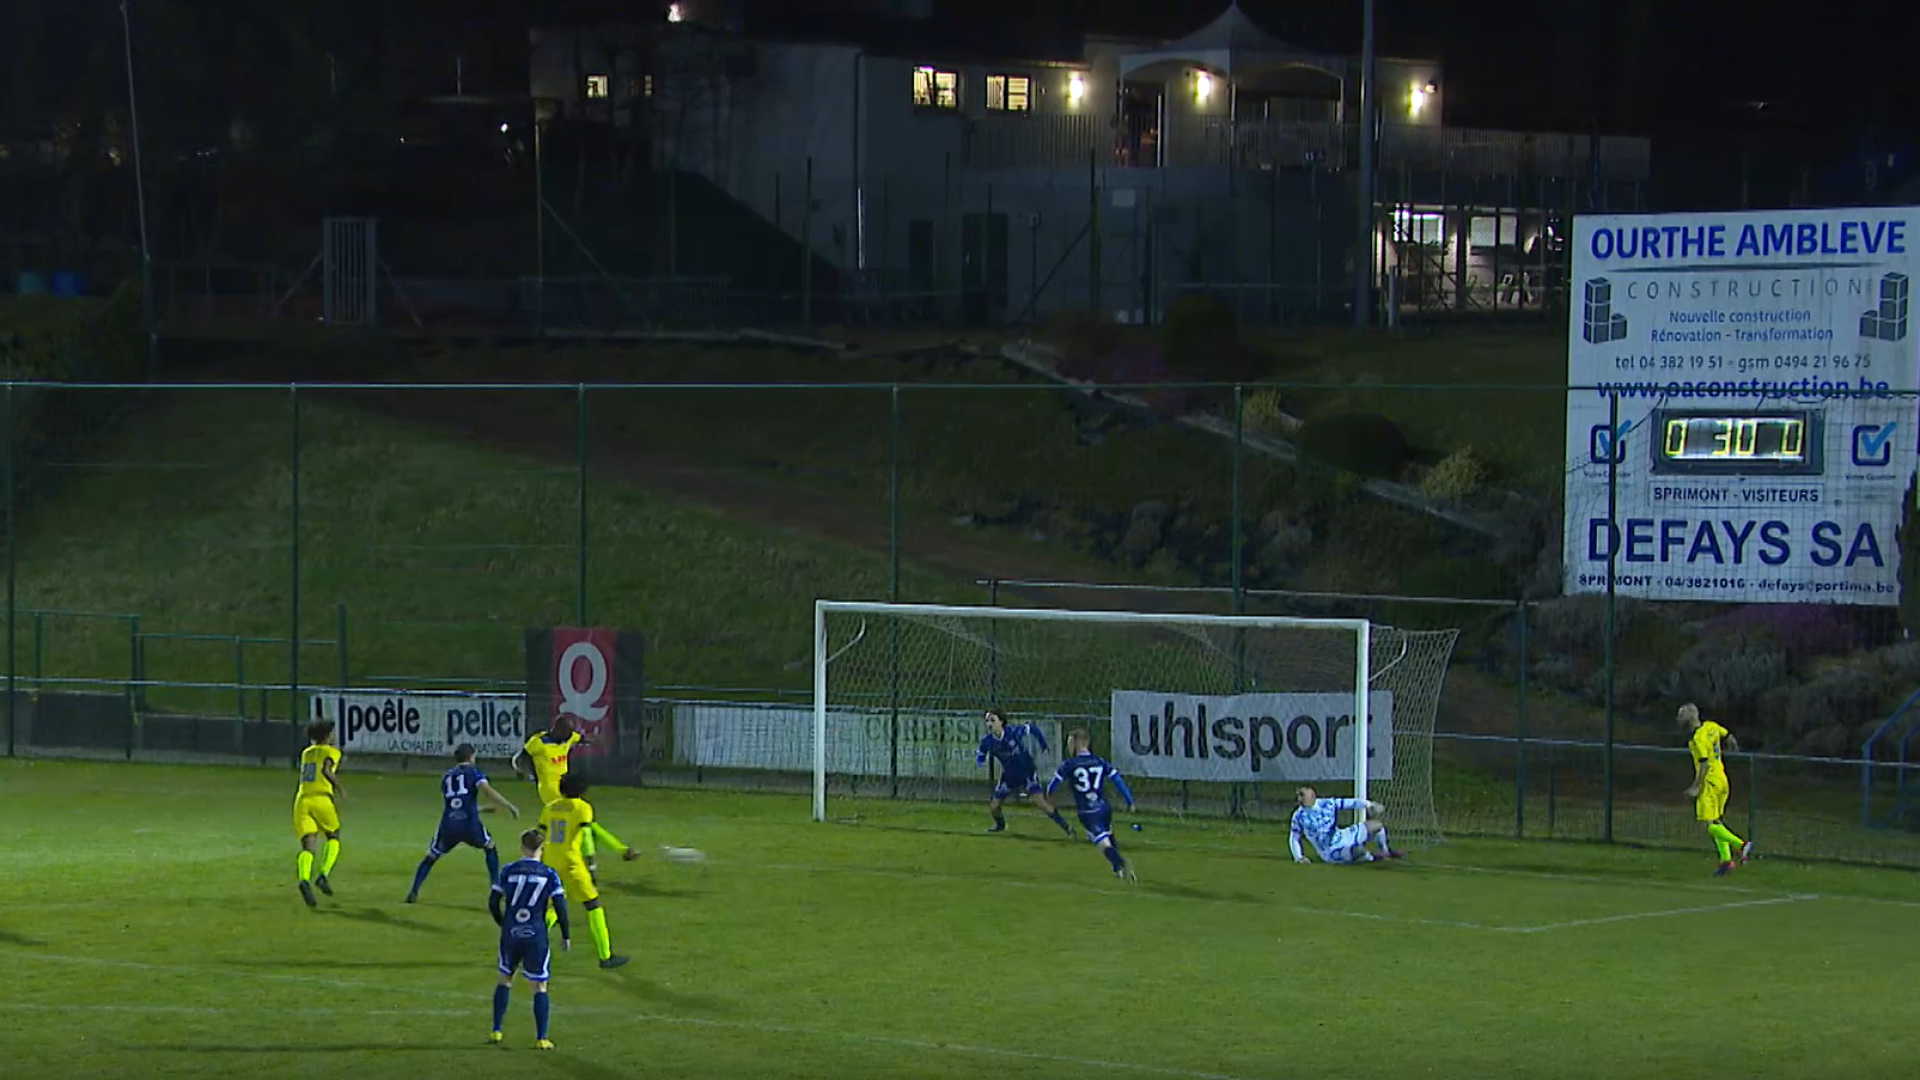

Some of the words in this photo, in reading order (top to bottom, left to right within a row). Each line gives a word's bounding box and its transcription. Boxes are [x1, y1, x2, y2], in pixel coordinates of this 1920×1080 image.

[1591, 225, 1726, 260] OURTHE
[1735, 221, 1906, 257] AMBLEVE
[1628, 278, 1861, 300] CONSTRUCTION
[1669, 310, 1726, 324] Nouvelle
[1729, 308, 1811, 323] construction
[1651, 327, 1722, 342] Rénovation
[1734, 327, 1834, 342] Transformation
[1615, 355, 1635, 369] tel
[1659, 356, 1684, 368] 382
[1690, 356, 1704, 368] 19
[1707, 355, 1724, 368] 51
[1738, 357, 1770, 373] gsm
[1774, 355, 1808, 368] 0494
[1812, 355, 1828, 368] 21
[1833, 354, 1850, 368] 96
[1854, 353, 1872, 368] 75
[1597, 375, 1890, 398] www.oaconstruction.be
[1711, 418, 1758, 456] 30
[1653, 487, 1729, 501] SPRIMONT
[1742, 488, 1820, 502] VISITEURS
[1588, 517, 1791, 566] DEFAYS
[1809, 520, 1885, 567] SA
[1579, 573, 1653, 586] SPRMONT
[558, 641, 609, 721] Q
[347, 698, 421, 742] poêle
[446, 700, 523, 746] pellet
[444, 774, 469, 798] 11
[1073, 765, 1104, 793] 37
[507, 874, 548, 907] 77
